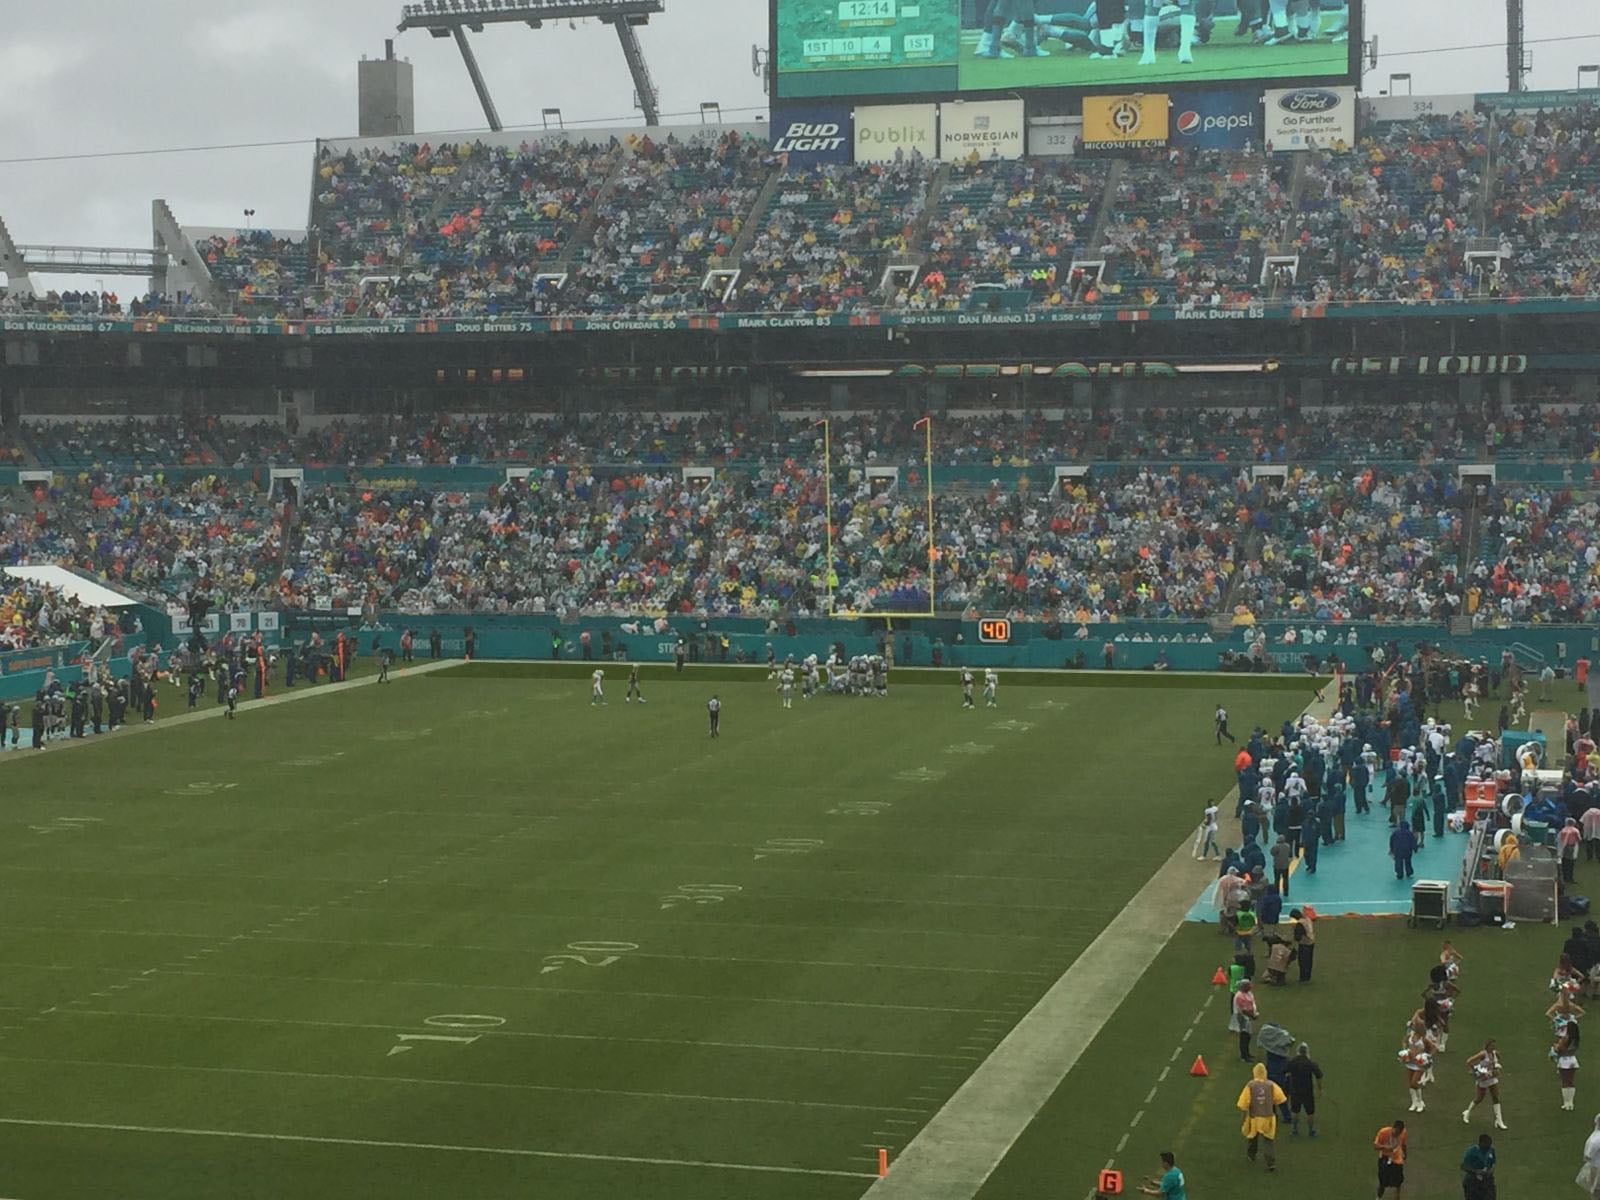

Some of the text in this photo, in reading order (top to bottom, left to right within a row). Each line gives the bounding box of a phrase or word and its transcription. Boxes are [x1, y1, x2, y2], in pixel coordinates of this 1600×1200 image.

[850, 2, 889, 16] 12:14
[807, 42, 829, 53] 1ST
[842, 41, 854, 51] 10
[909, 38, 930, 48] 1ST
[1289, 92, 1328, 110] Ford
[1413, 102, 1433, 112] 334
[1203, 112, 1254, 133] pepsi
[1283, 116, 1334, 125] Go Further
[786, 123, 839, 137] BUD
[859, 126, 927, 144] Publix
[945, 131, 1019, 142] NORWEGIAN
[1047, 135, 1066, 145] 332
[773, 137, 845, 152] LIGHT
[1024, 313, 1036, 324] 13
[1174, 310, 1207, 320] MARK
[1209, 308, 1245, 319] DUPER
[98, 322, 113, 332] 67
[519, 322, 532, 332] 75
[662, 320, 676, 330] 56
[816, 316, 831, 327] 83
[392, 324, 406, 333] 73
[1418, 355, 1527, 374] LOUD
[983, 621, 1006, 640] 40
[541, 941, 640, 968] 20
[396, 1014, 507, 1045] 10
[1103, 1172, 1117, 1192] G
